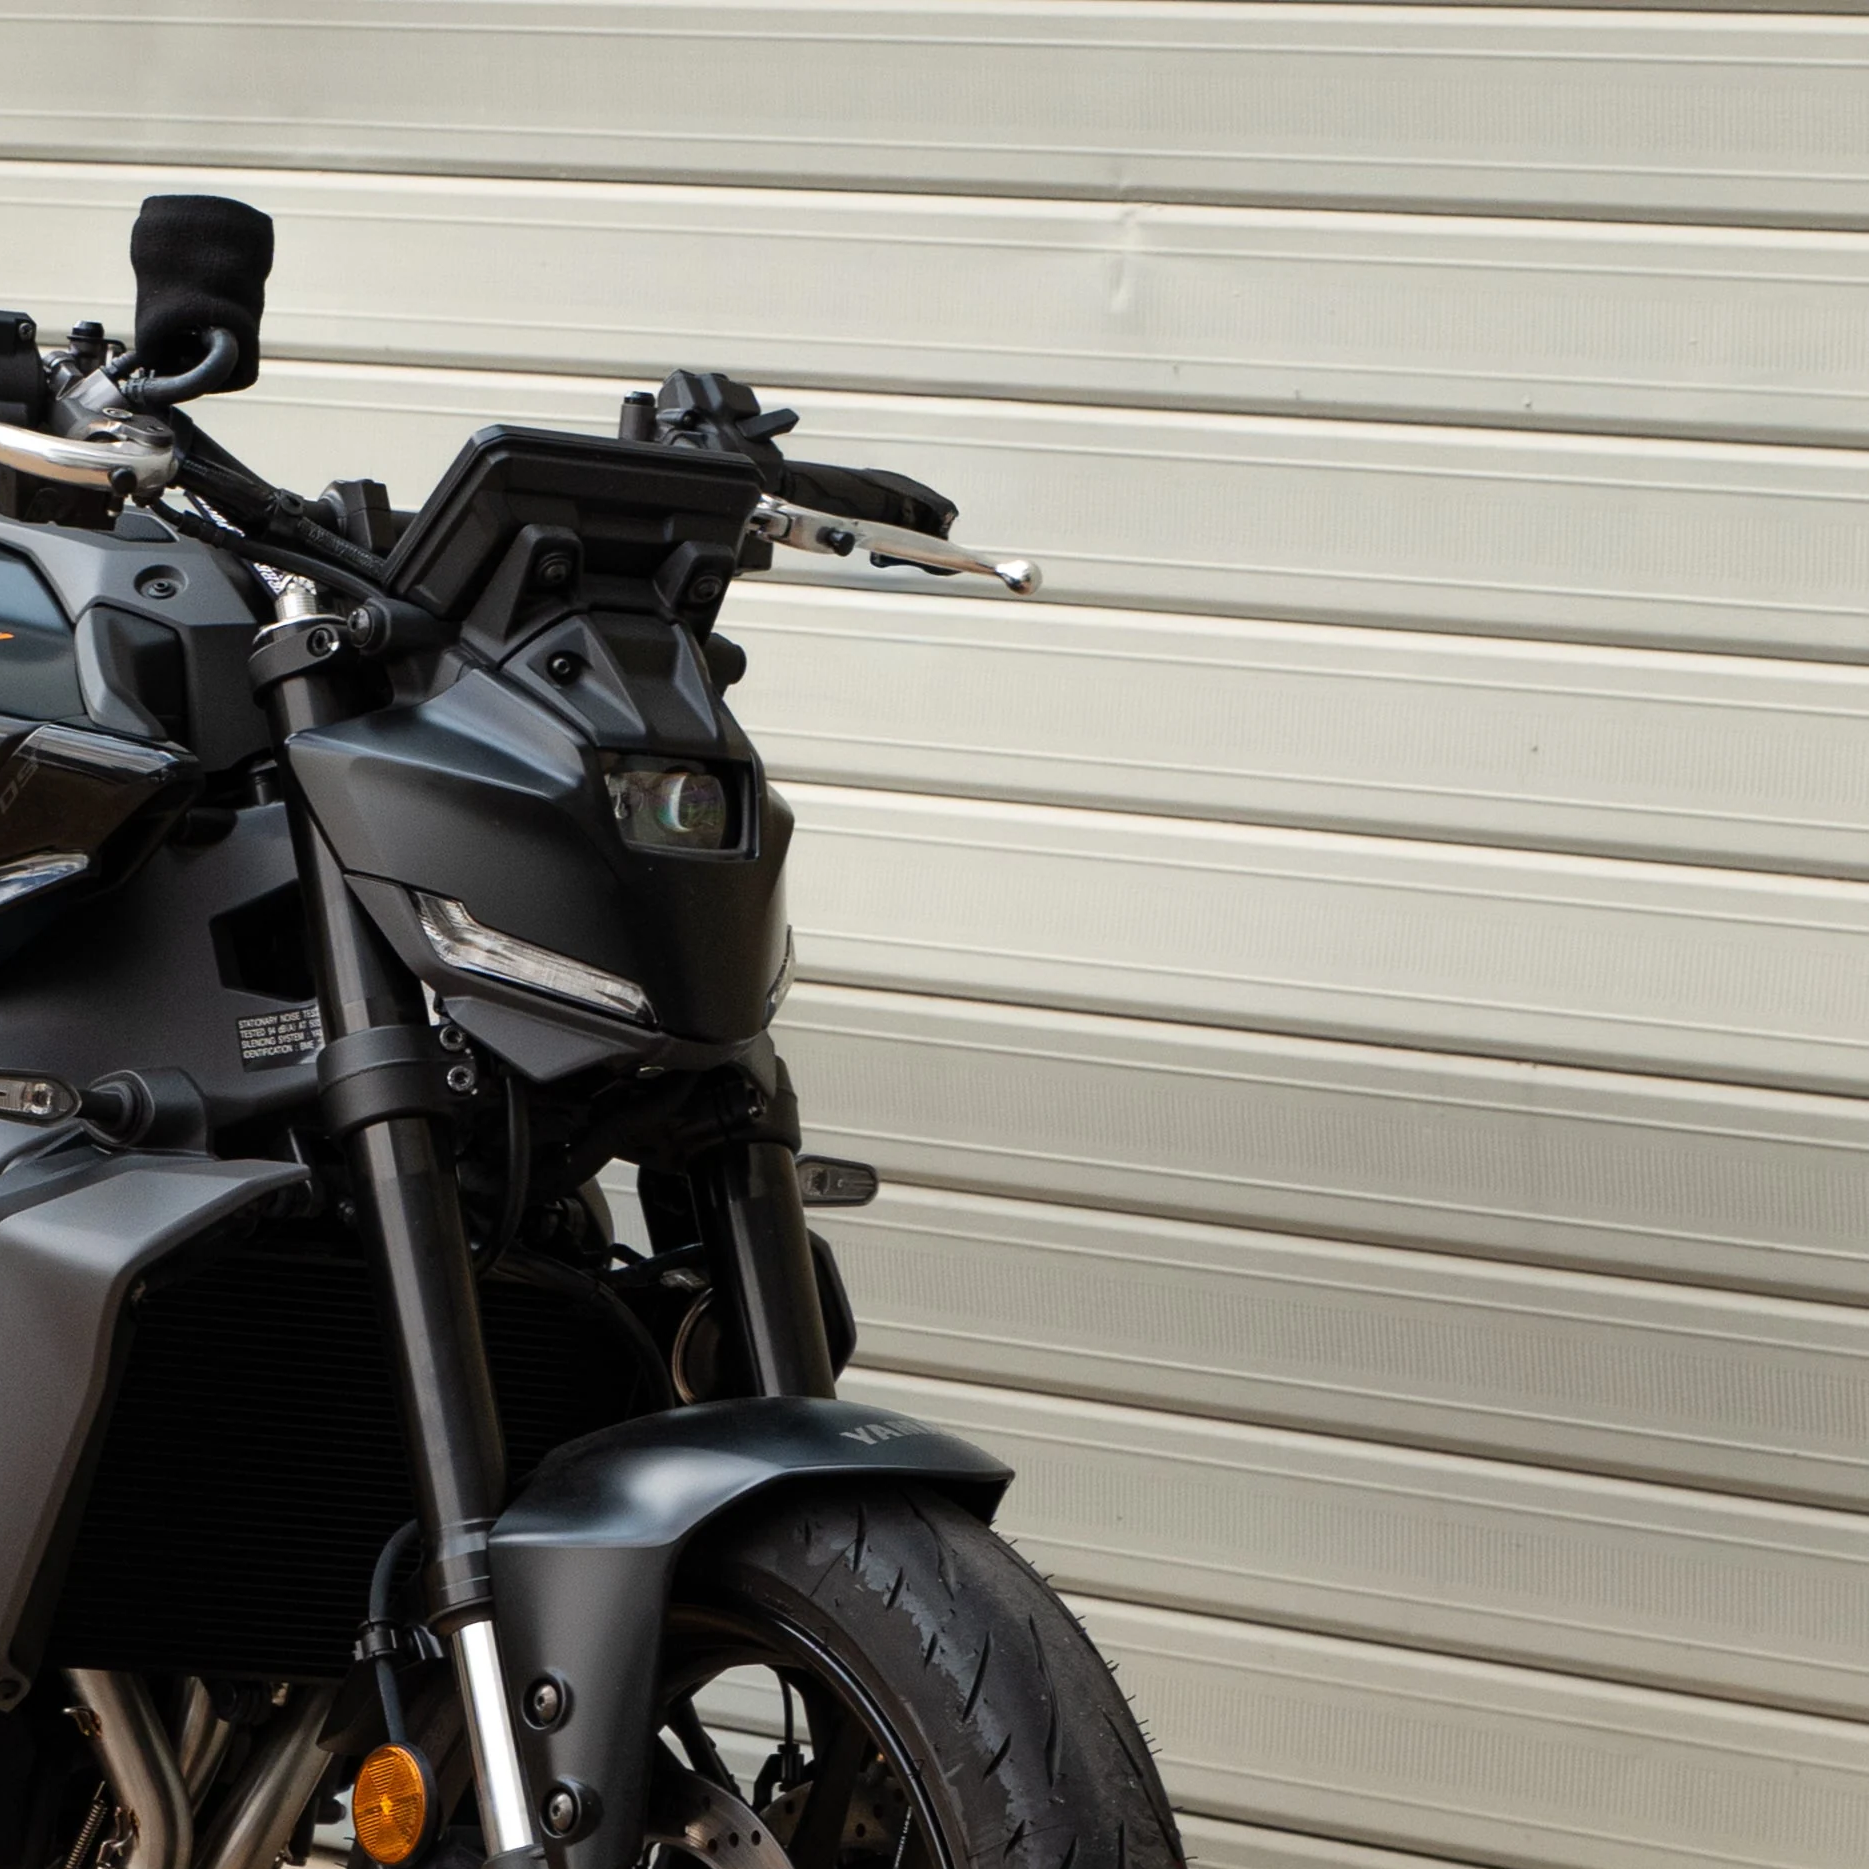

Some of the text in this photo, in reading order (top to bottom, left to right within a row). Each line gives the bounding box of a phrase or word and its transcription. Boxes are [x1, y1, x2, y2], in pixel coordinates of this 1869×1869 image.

[238, 1016, 277, 1029] STATIONARY
[280, 1012, 300, 1021] NOISE
[239, 1027, 266, 1038] TESTED
[241, 1036, 276, 1049] SILENCING
[278, 1032, 304, 1044] SYSTEM
[243, 1045, 292, 1058] IDENTIFICATION
